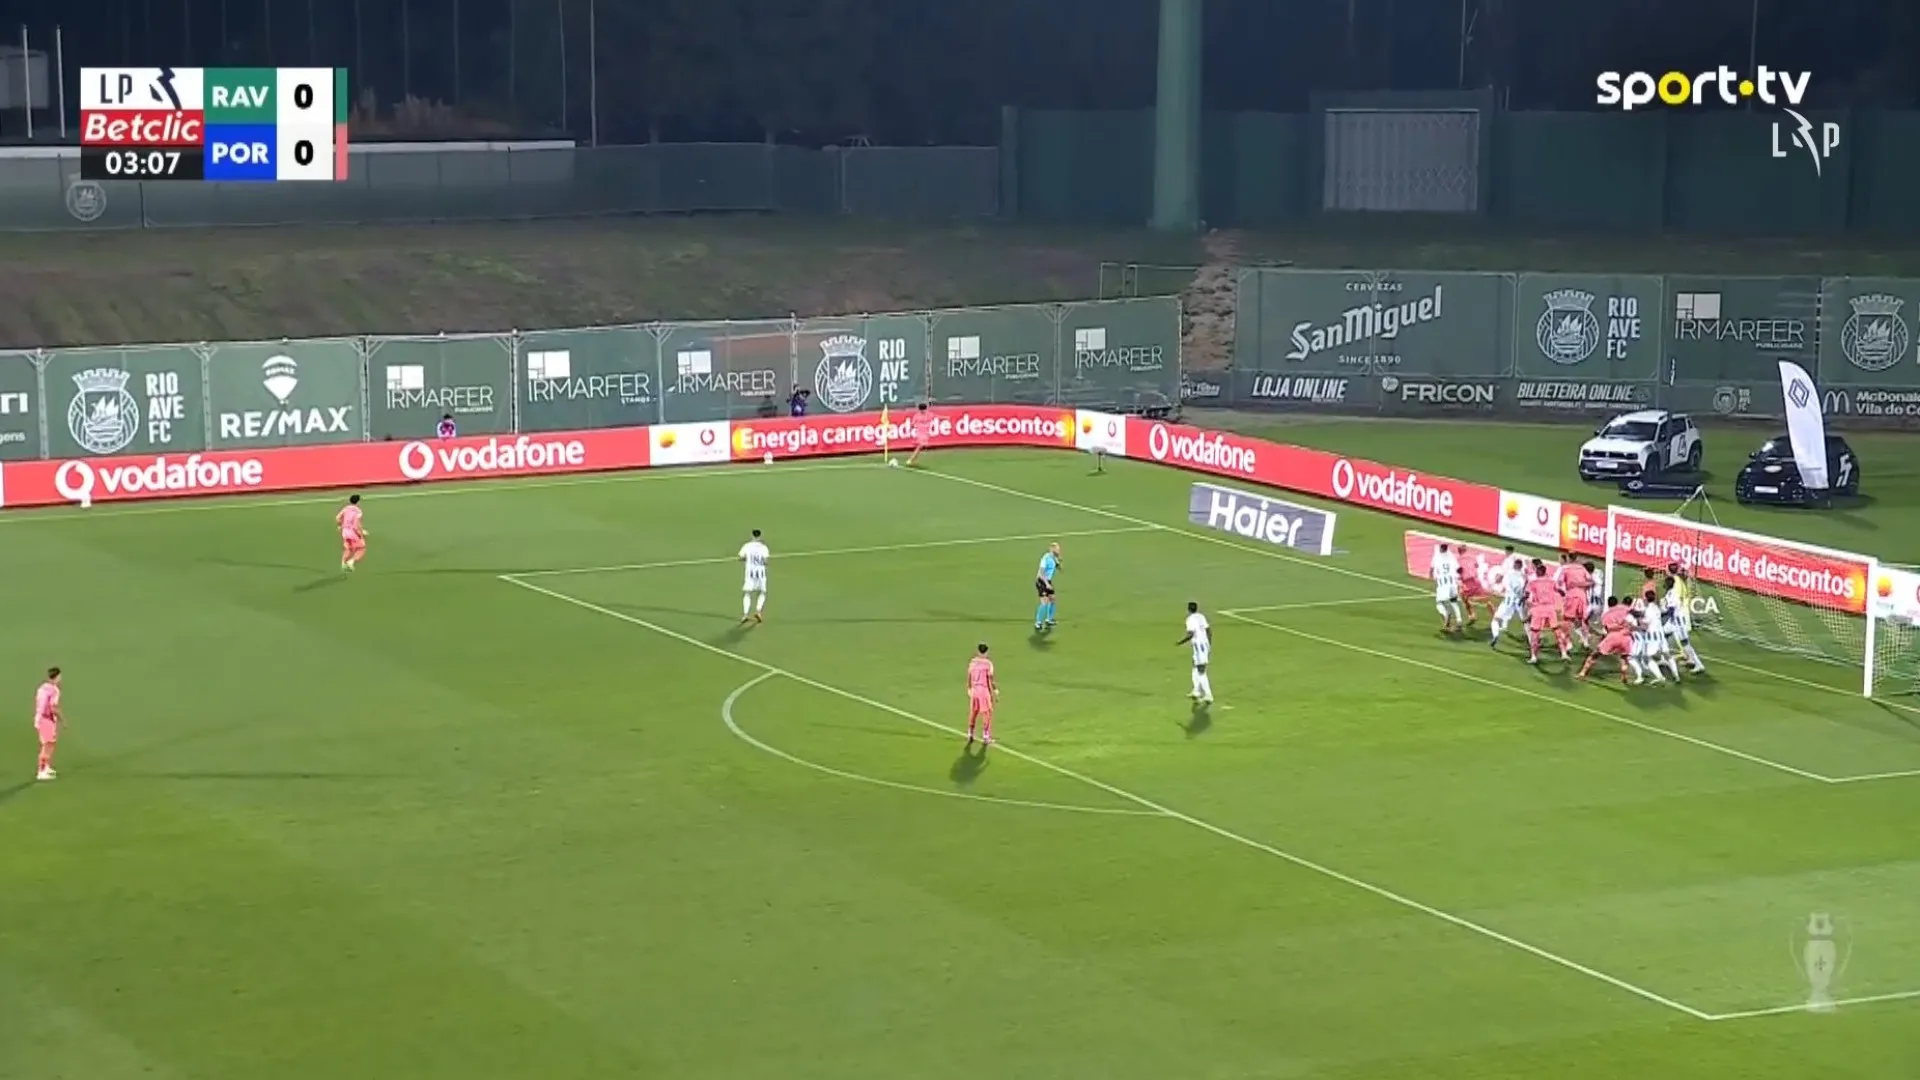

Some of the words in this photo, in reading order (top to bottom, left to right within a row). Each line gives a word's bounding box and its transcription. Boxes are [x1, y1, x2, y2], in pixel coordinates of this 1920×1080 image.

[1345, 281, 1403, 293] CERVEZAS
[1607, 297, 1638, 317] RIO
[1607, 318, 1641, 338] AVE
[1675, 318, 1805, 343] IRMARFER
[879, 337, 906, 359] RIO
[1075, 344, 1163, 370] IRMARFER
[1338, 354, 1372, 365] SINCE
[1373, 354, 1402, 365] 1890
[1607, 339, 1628, 360] FC
[879, 360, 910, 382] AVE
[948, 352, 1040, 378] IRMARFER
[145, 372, 179, 396] RIO
[528, 371, 651, 403] IRMARFER
[678, 369, 776, 396] IRMARFER
[879, 383, 899, 404] FC
[1252, 376, 1289, 397] LOJA
[1293, 377, 1349, 399] ONLINE
[1401, 383, 1494, 403] FRICON
[1517, 382, 1587, 400] BILHETEIRA
[1588, 384, 1636, 401] ONLINE
[148, 395, 185, 420] AVE
[386, 385, 494, 410] IRMARFER
[1856, 404, 1883, 416] Vila
[1885, 404, 1903, 416] do
[149, 421, 172, 444] FC
[220, 406, 350, 440] RE/MAX
[738, 422, 818, 452] Energia
[926, 415, 952, 438] de
[956, 410, 1066, 438] descontos
[438, 437, 585, 472] vodafone
[1171, 431, 1256, 473] vodafone
[98, 454, 263, 494] vodafone
[1357, 469, 1454, 517] vodafone
[1207, 490, 1303, 548] Haier
[1567, 514, 1632, 551] Eneria
[1635, 533, 1724, 570] carregada
[1727, 549, 1751, 575] de
[1754, 557, 1856, 599] descontos
